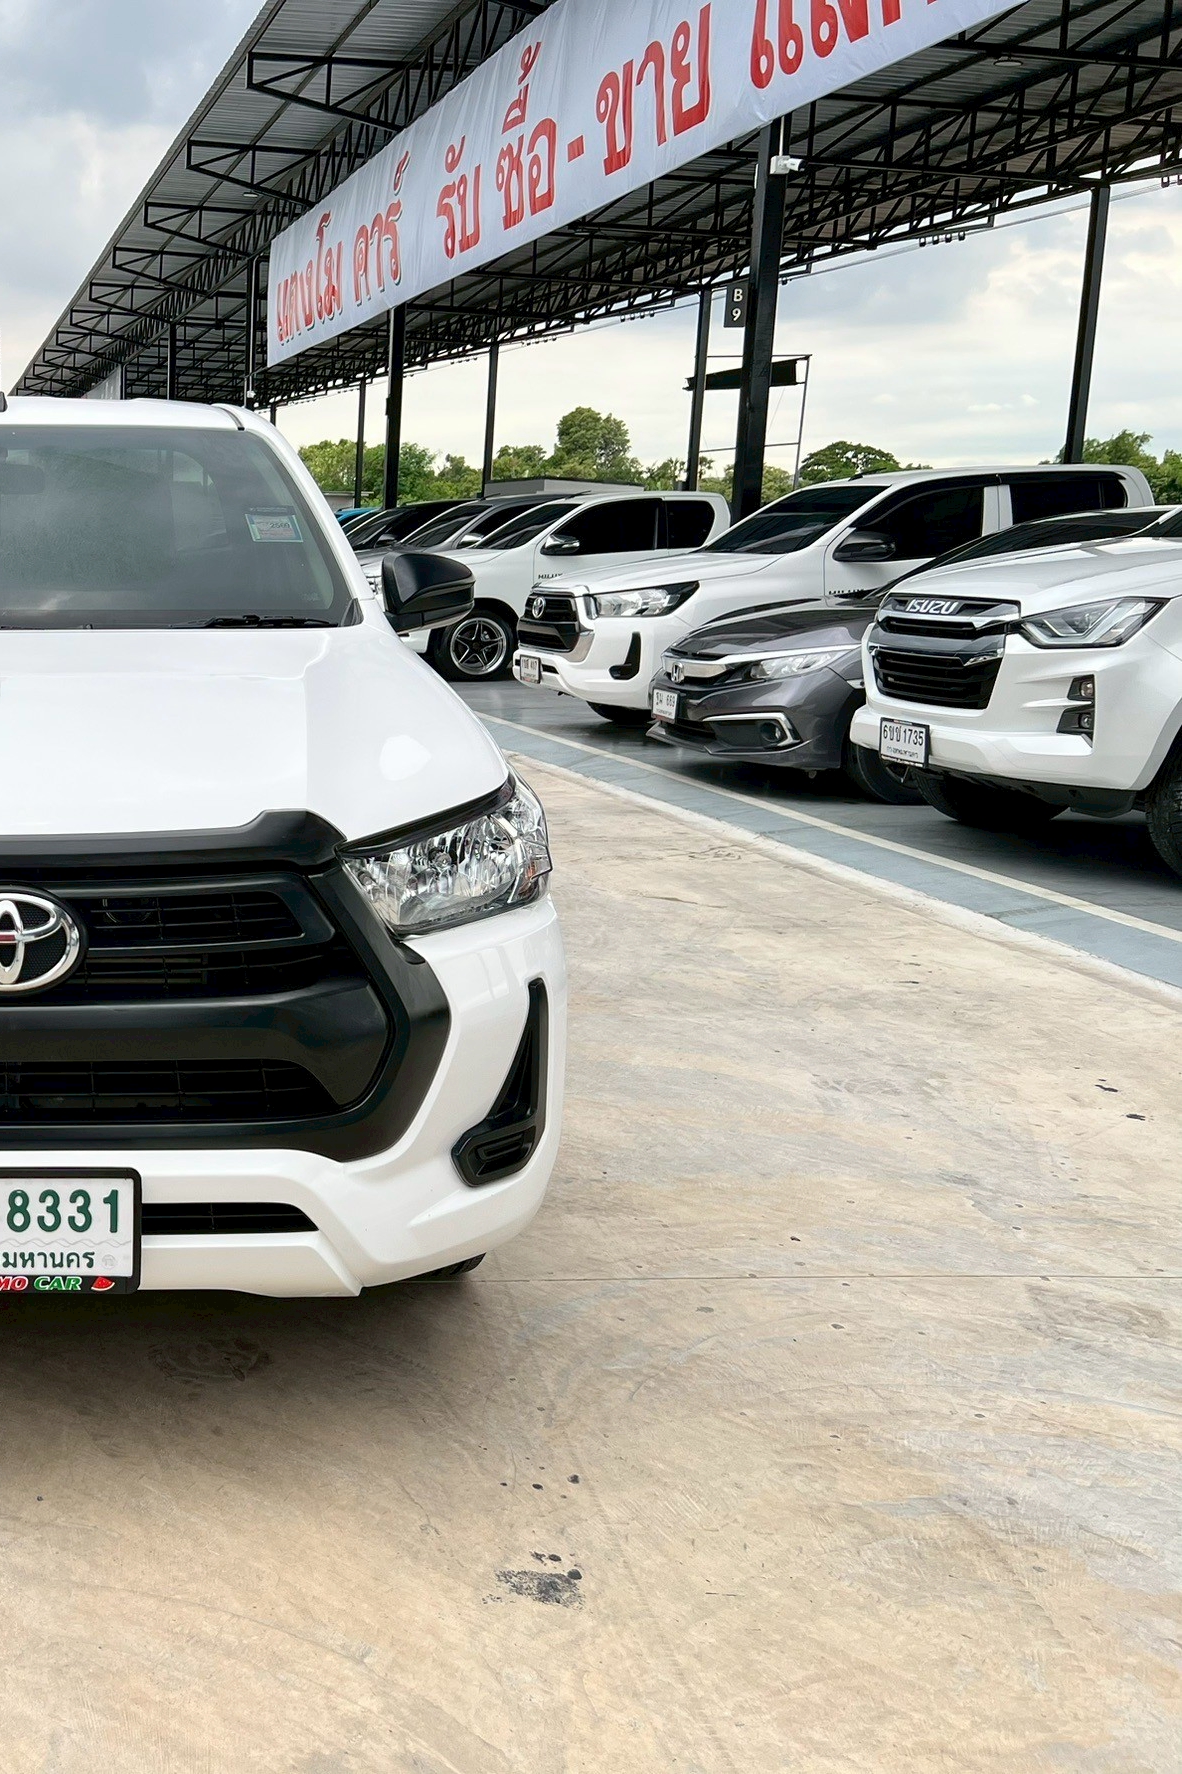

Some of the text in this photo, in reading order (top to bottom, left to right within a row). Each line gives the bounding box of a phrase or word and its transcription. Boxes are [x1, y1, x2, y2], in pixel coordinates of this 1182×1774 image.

[277, 210, 344, 345] แตงโม
[353, 150, 411, 307] คาร์
[436, 135, 481, 260] รับ
[733, 288, 744, 302] B
[732, 307, 742, 321] 9
[905, 599, 958, 614] ISUZU
[903, 728, 924, 746] 1735
[6, 1188, 119, 1234] 8331
[33, 1276, 82, 1291] CAR
